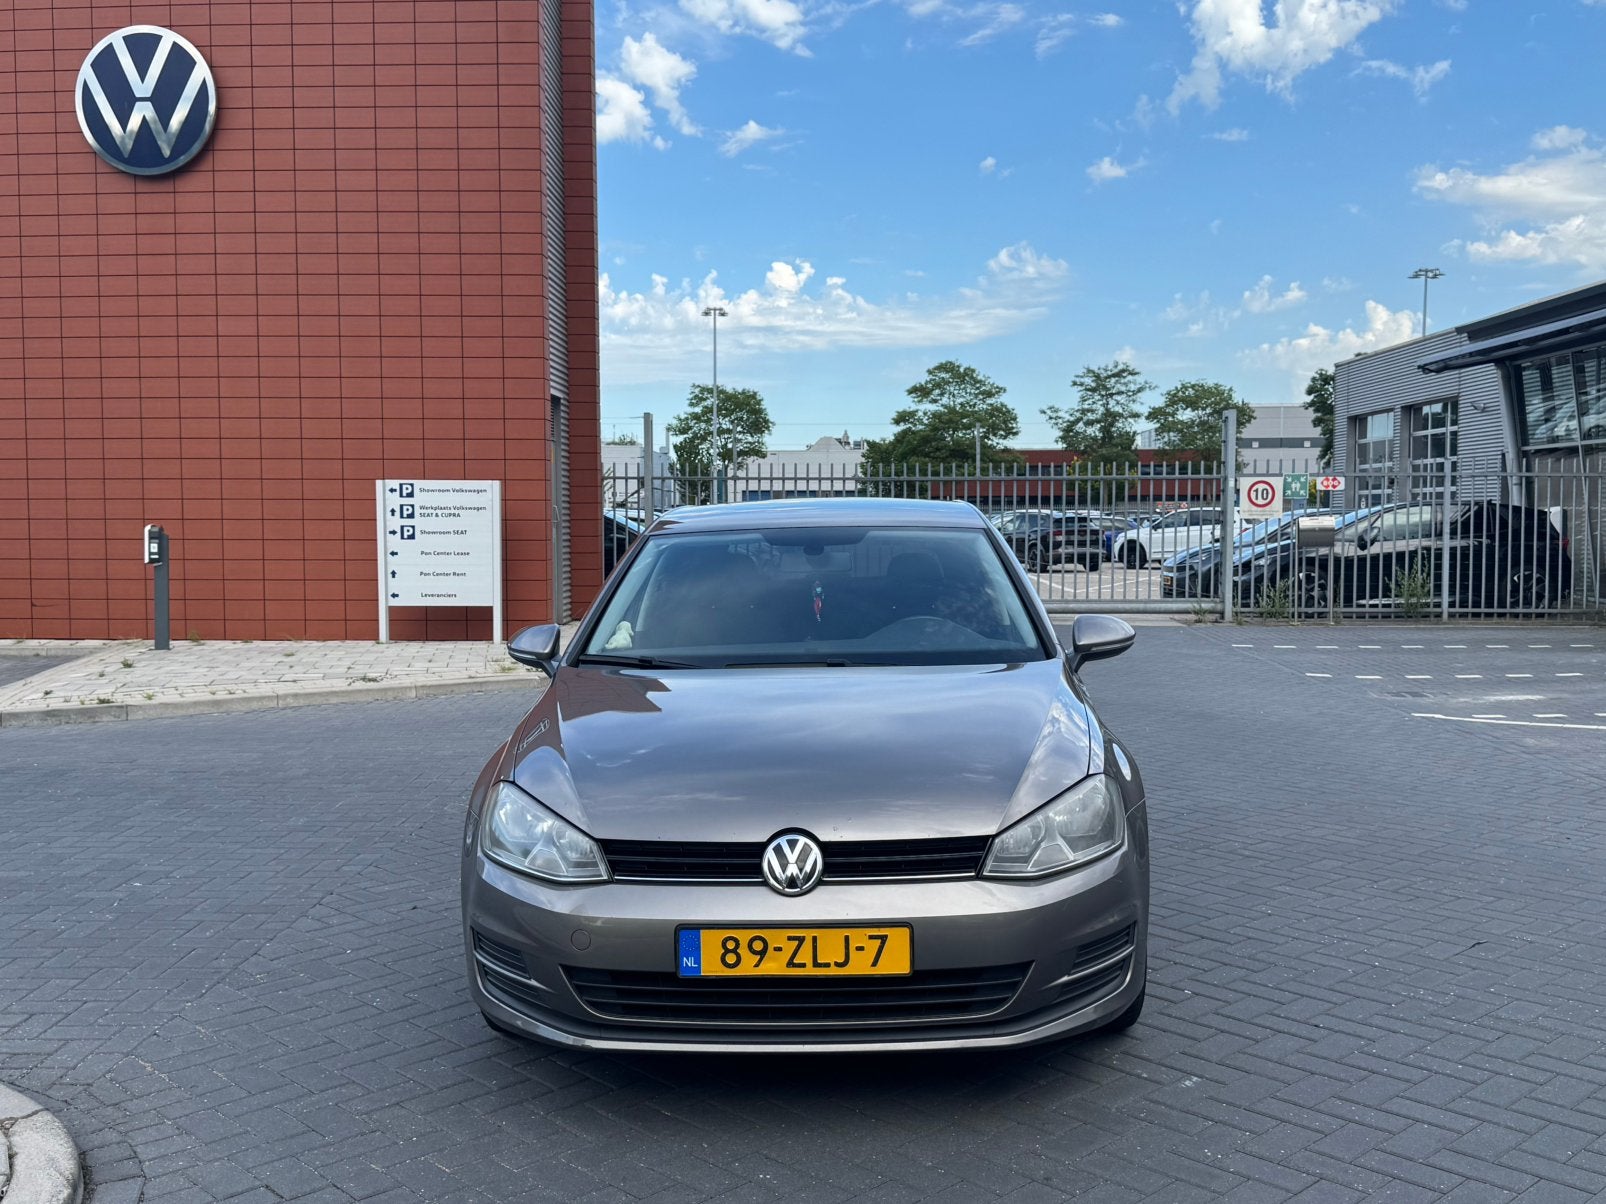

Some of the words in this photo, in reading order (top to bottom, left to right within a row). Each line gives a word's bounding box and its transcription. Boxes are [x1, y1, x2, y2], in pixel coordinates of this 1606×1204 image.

[402, 484, 412, 497] P
[451, 487, 487, 495] Volkswagen
[1252, 488, 1269, 501] 10
[403, 505, 412, 518] P
[403, 526, 413, 539] P
[720, 934, 889, 969] 89-ZLJ-7
[683, 957, 698, 967] NL
